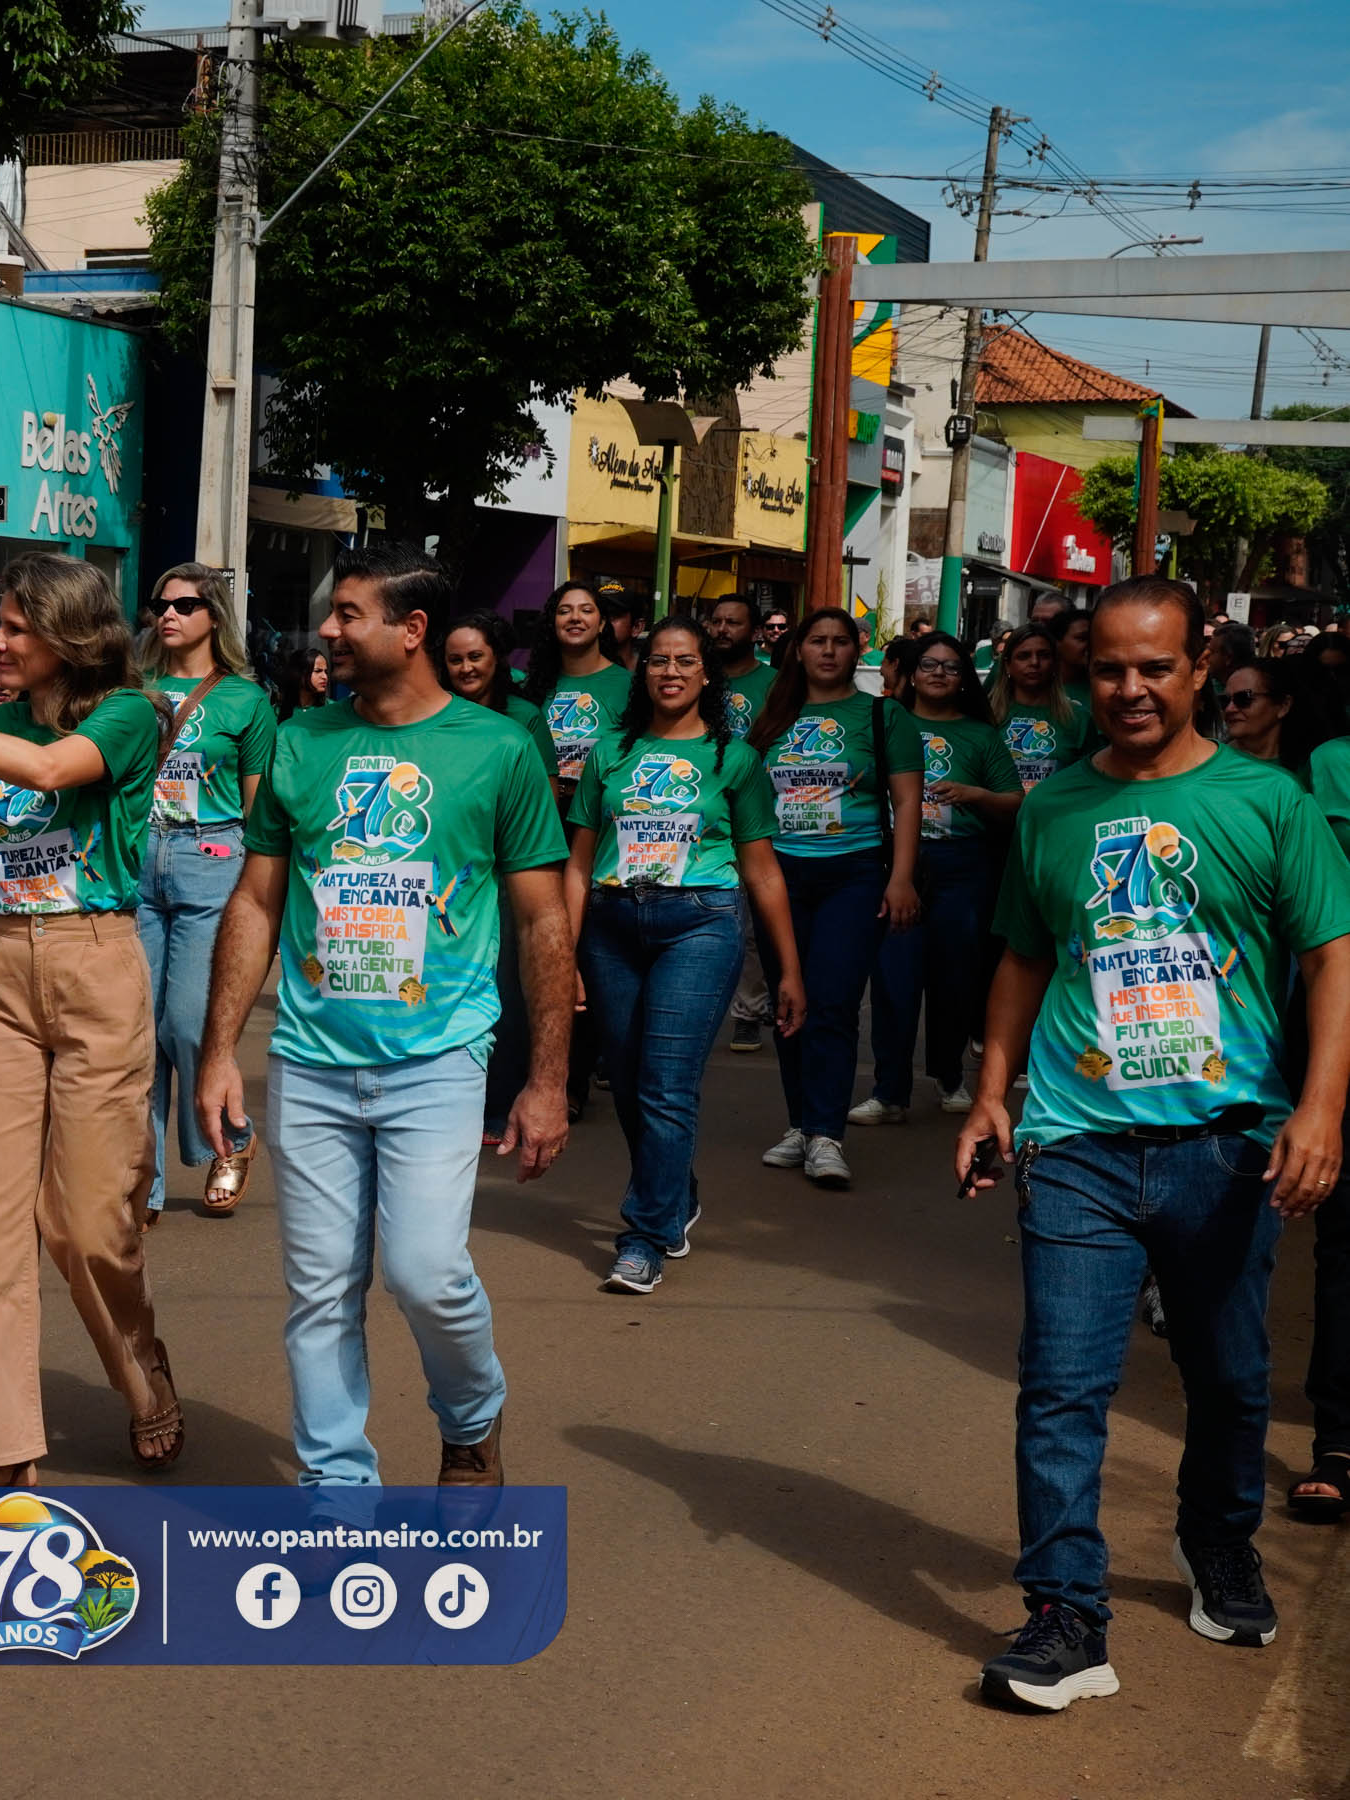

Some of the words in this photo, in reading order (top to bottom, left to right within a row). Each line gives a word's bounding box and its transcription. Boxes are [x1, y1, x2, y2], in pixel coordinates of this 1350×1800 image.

[21, 411, 91, 475] Bellas
[30, 478, 98, 538] Artes
[550, 693, 600, 732] 78
[790, 719, 846, 756] 78
[1009, 720, 1056, 753] 78
[182, 761, 198, 769] QUE
[349, 758, 395, 771] BONITO
[642, 754, 676, 763] BONITO
[635, 758, 701, 804] 78
[773, 768, 826, 779] NATUREZA
[827, 770, 844, 778] QUE
[343, 762, 433, 849] 78
[648, 808, 672, 816] ANOS
[801, 811, 836, 820] GENTE
[620, 820, 676, 831] NATUREZA
[678, 824, 693, 832] QUE
[1099, 816, 1150, 838] BONITO
[47, 843, 69, 857] QUE
[359, 852, 391, 865] ANOS
[1092, 822, 1199, 922] 78
[318, 872, 398, 889] NATUREZA
[402, 877, 426, 890] QUE
[325, 925, 343, 938] QUE
[1133, 924, 1169, 940] ANOS
[327, 939, 395, 956] FUTURO
[327, 959, 350, 972] QUE
[351, 961, 358, 971] A
[360, 957, 415, 974] GENTE
[1092, 946, 1180, 974] NATUREZA
[1181, 949, 1210, 964] QUE
[328, 973, 393, 994] CUIDA.
[1110, 1010, 1134, 1026] QUE
[1115, 1019, 1195, 1042] FUTURO
[1117, 1044, 1147, 1060] QUE
[1150, 1044, 1158, 1056] A
[1159, 1035, 1215, 1056] GENTE
